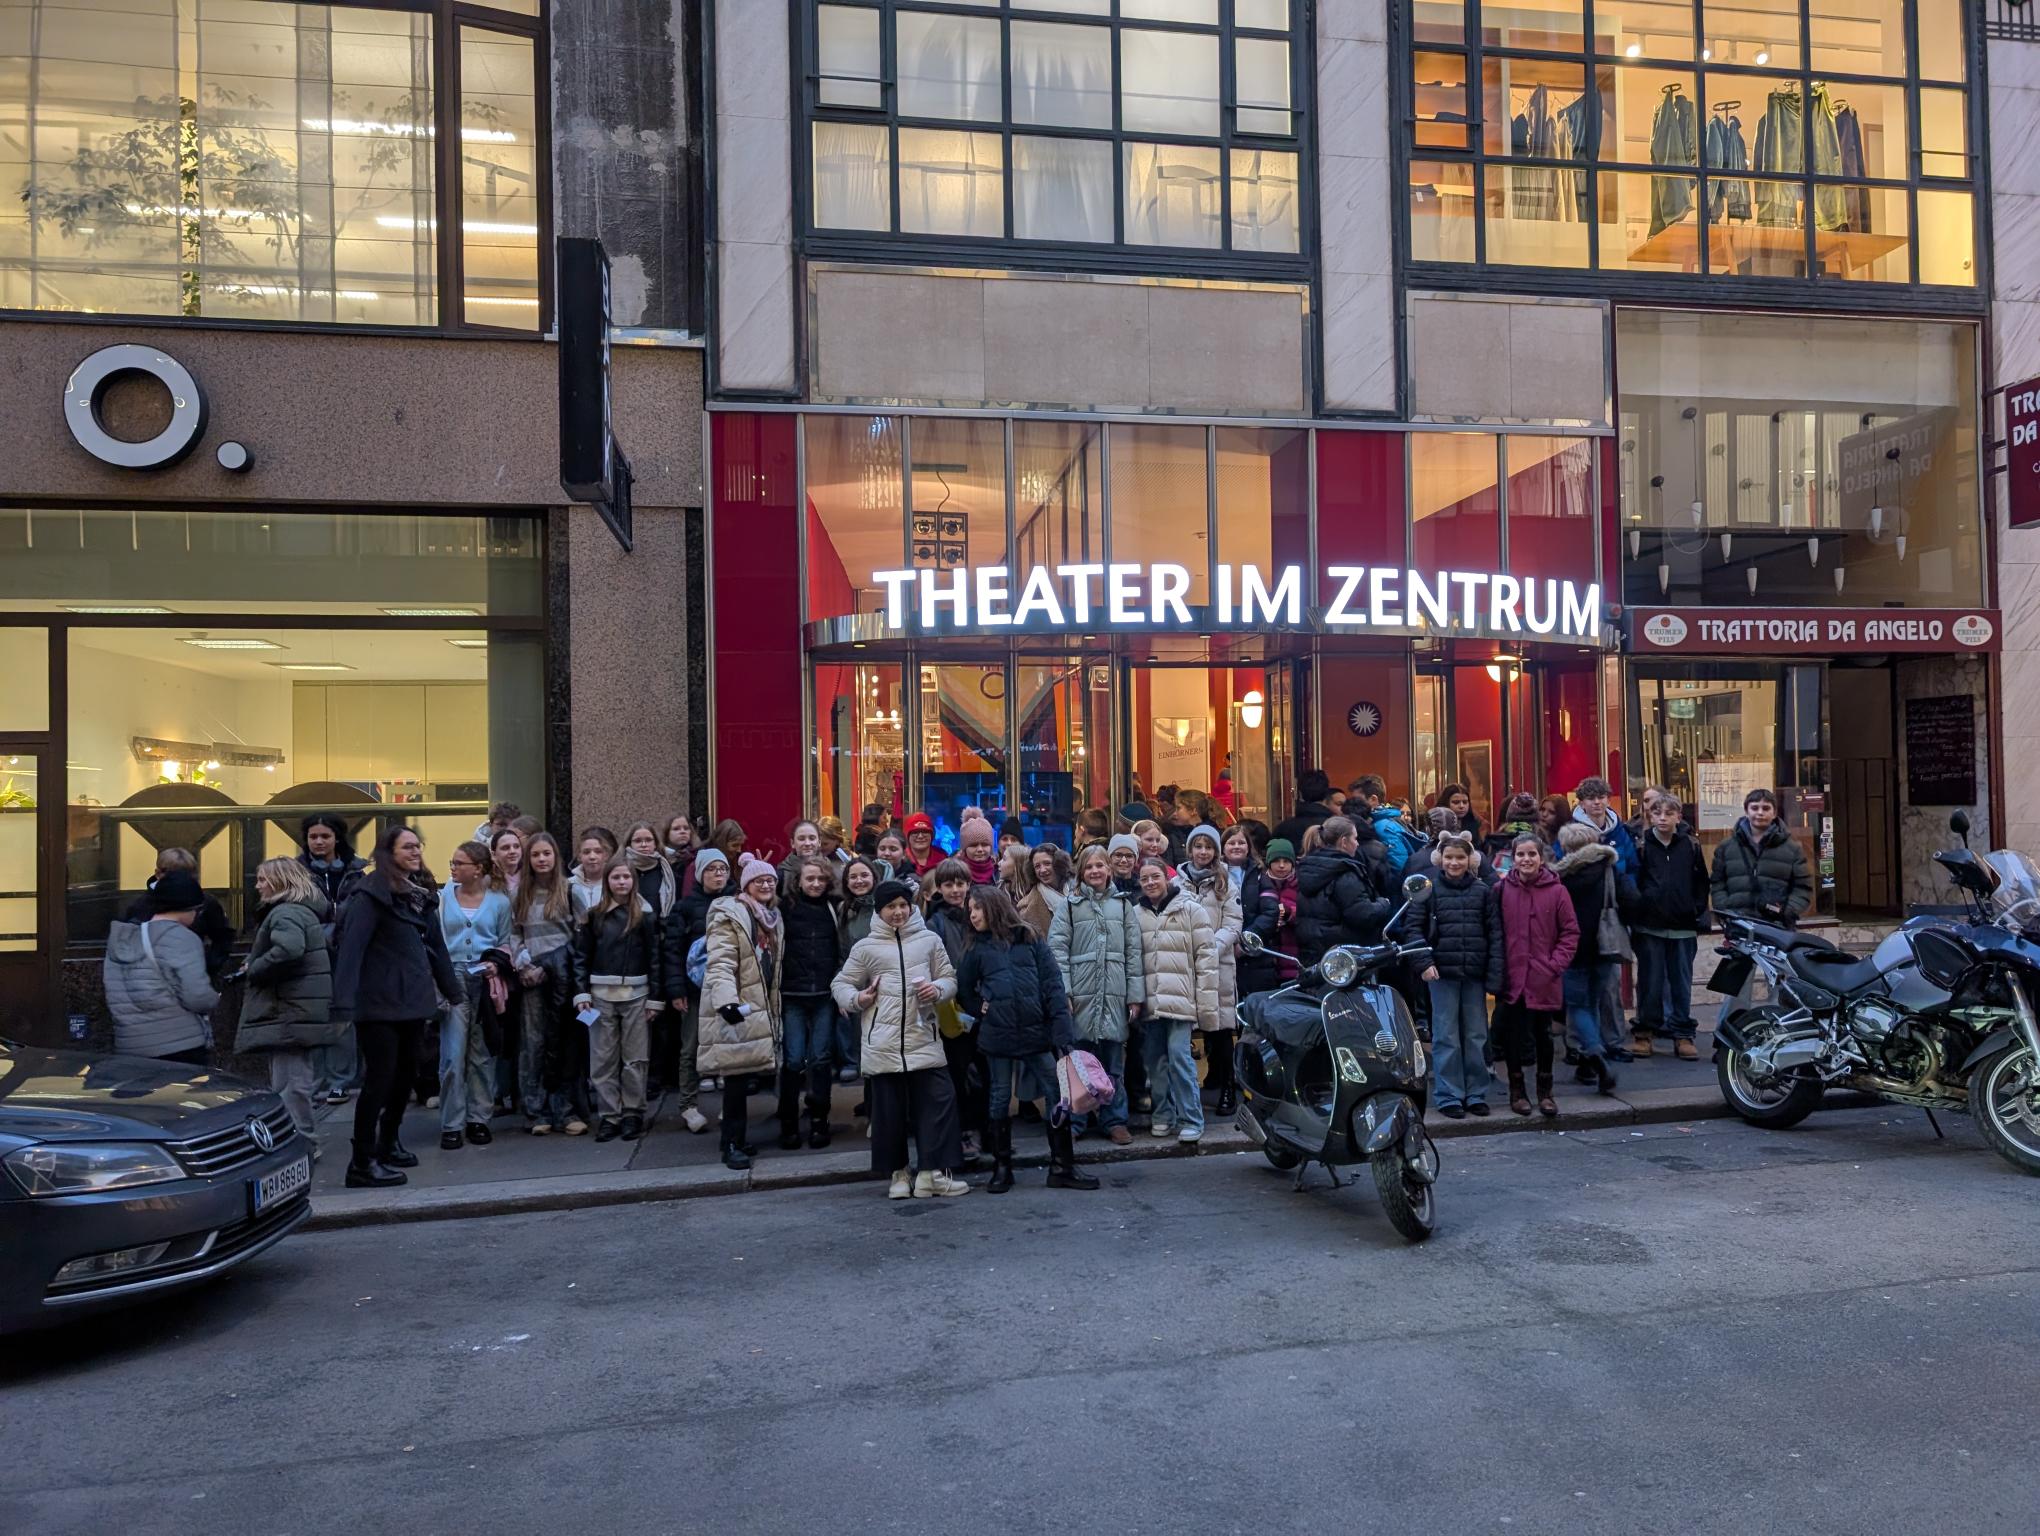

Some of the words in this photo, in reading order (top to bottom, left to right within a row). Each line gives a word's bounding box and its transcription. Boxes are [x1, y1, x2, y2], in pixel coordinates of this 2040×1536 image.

[2010, 388, 2040, 417] TR
[2012, 420, 2037, 446] DA
[872, 563, 1193, 629] THEATER
[1217, 564, 1300, 624] IM
[1324, 566, 1600, 637] ZENTRUM
[1698, 619, 1819, 643] TRATTORIA
[1828, 620, 1856, 643] DA
[1864, 620, 1944, 643] ANGELO
